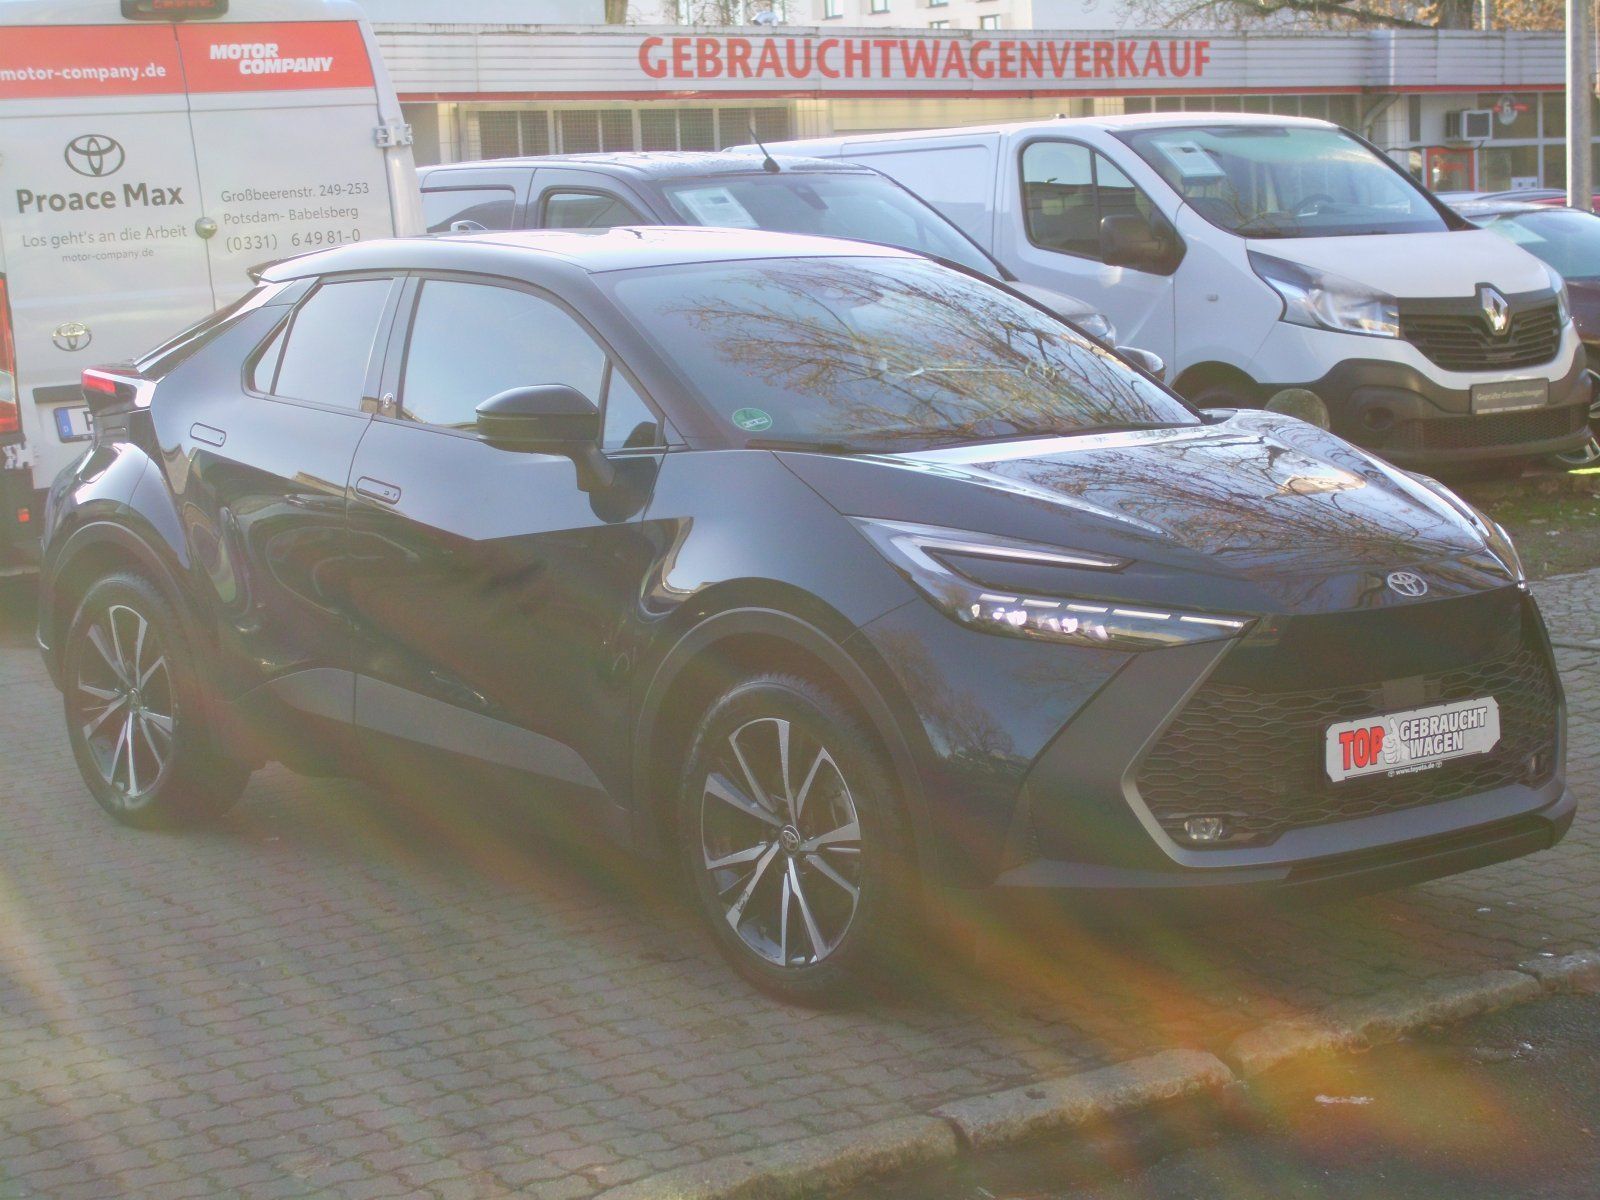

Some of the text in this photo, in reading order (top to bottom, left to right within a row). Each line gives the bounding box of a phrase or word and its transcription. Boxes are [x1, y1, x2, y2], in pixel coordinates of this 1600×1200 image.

[210, 43, 279, 60] MOTOR
[638, 36, 1210, 79] GEBRAUCHTWAGENVERKAUF
[0, 63, 166, 82] motor-company.de
[240, 57, 333, 75] COMPANY
[16, 182, 184, 214] Proace Max
[221, 182, 369, 203] Großbeerenstr. 249-253
[223, 206, 359, 225] Potsdam- Babelsberg
[22, 225, 188, 249] Los geht's an die Arbeit
[226, 233, 278, 254] (0331)
[1339, 706, 1488, 771] TOP GEBRAUCHT
[1409, 731, 1464, 759] WAGEN
